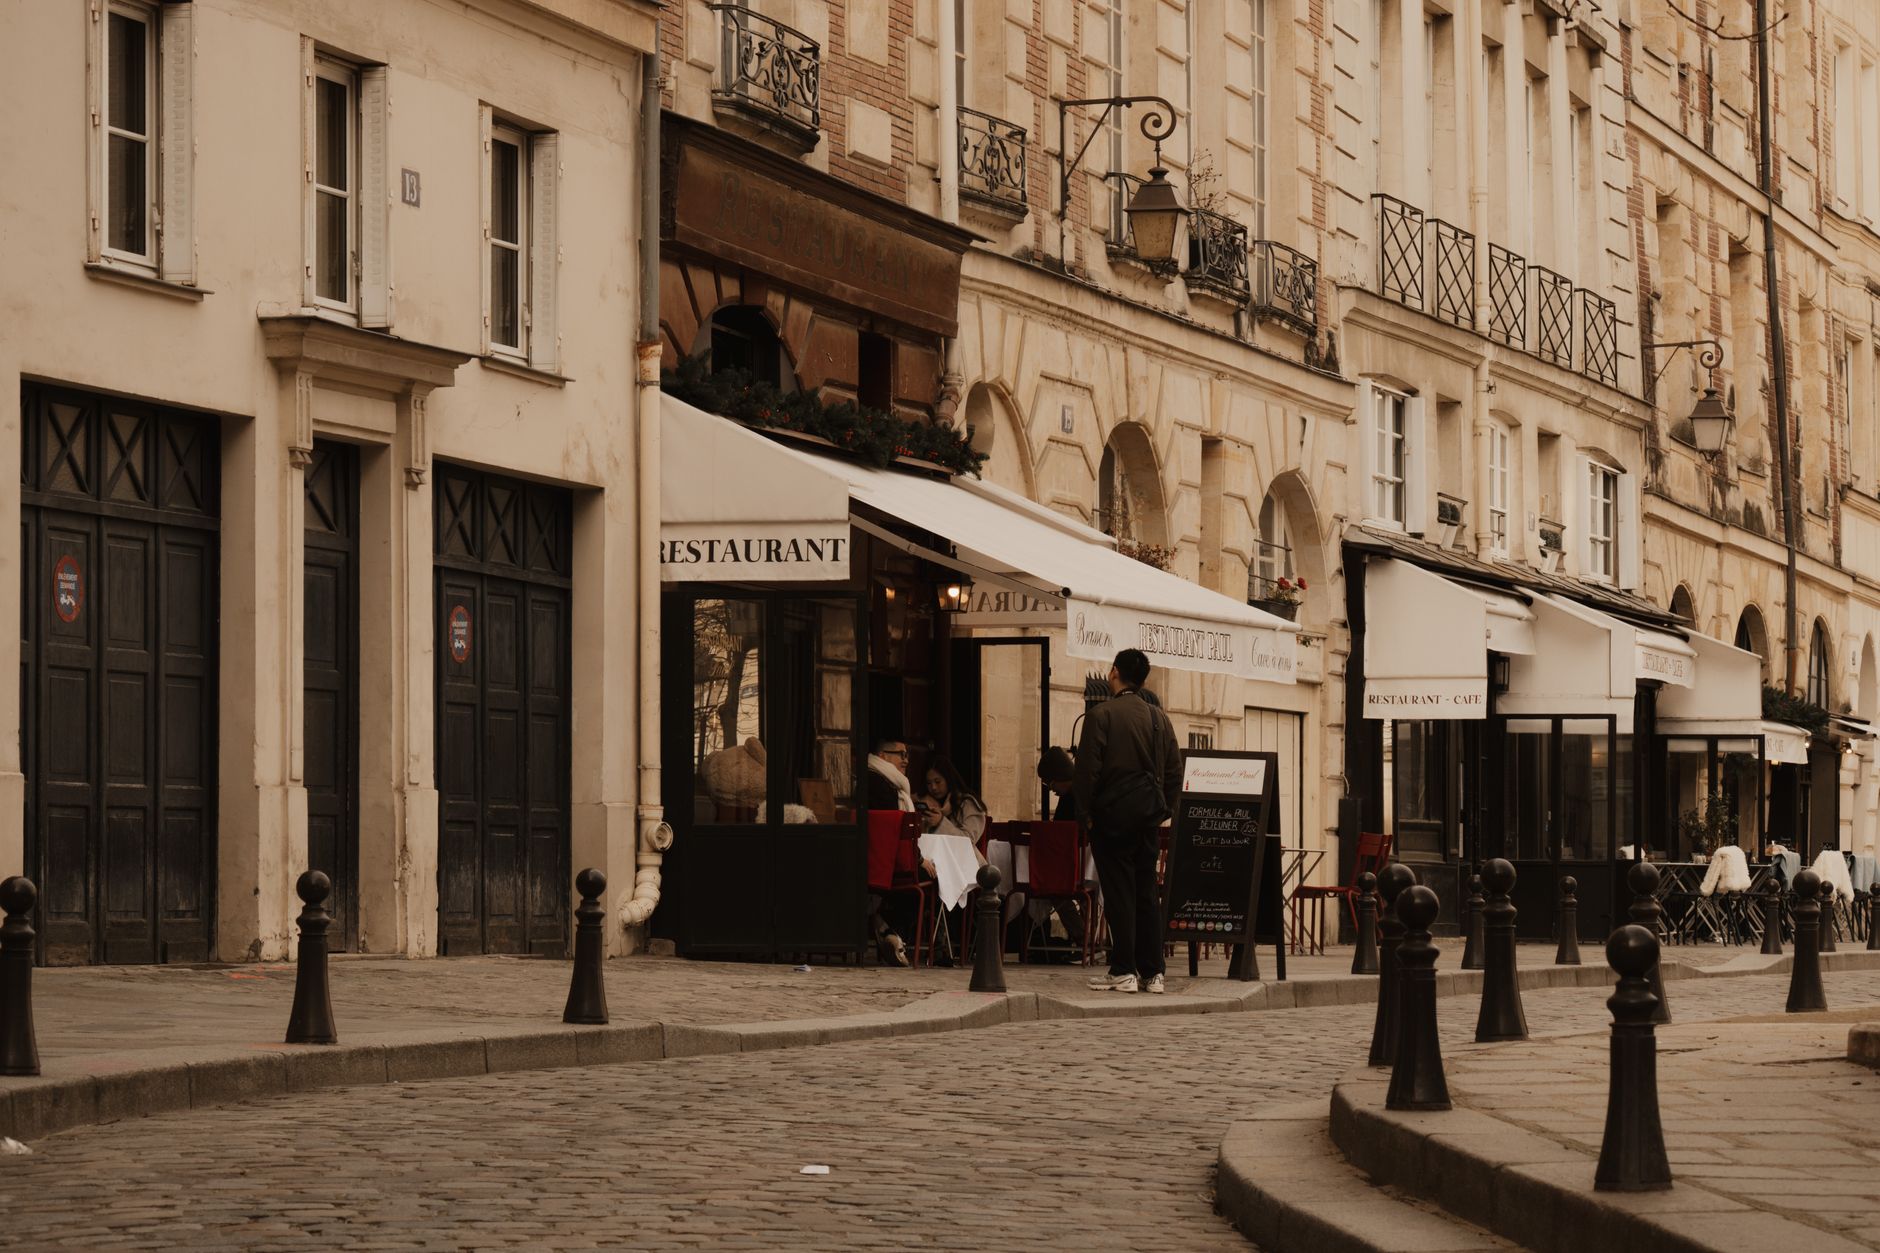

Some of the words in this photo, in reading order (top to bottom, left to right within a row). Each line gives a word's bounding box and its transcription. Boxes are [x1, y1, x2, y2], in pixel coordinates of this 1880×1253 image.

[405, 173, 417, 202] 13
[716, 171, 930, 295] RESTAURANT
[660, 538, 846, 564] ESTAURANT
[1139, 623, 1205, 659] RESTAURANT
[1207, 631, 1233, 662] PAUL
[1368, 694, 1442, 705] RESTAURANT
[1453, 694, 1482, 705] CAFE
[1188, 806, 1222, 818] FORMULE
[1234, 808, 1250, 818] PAUL
[1192, 834, 1219, 845] PLAT
